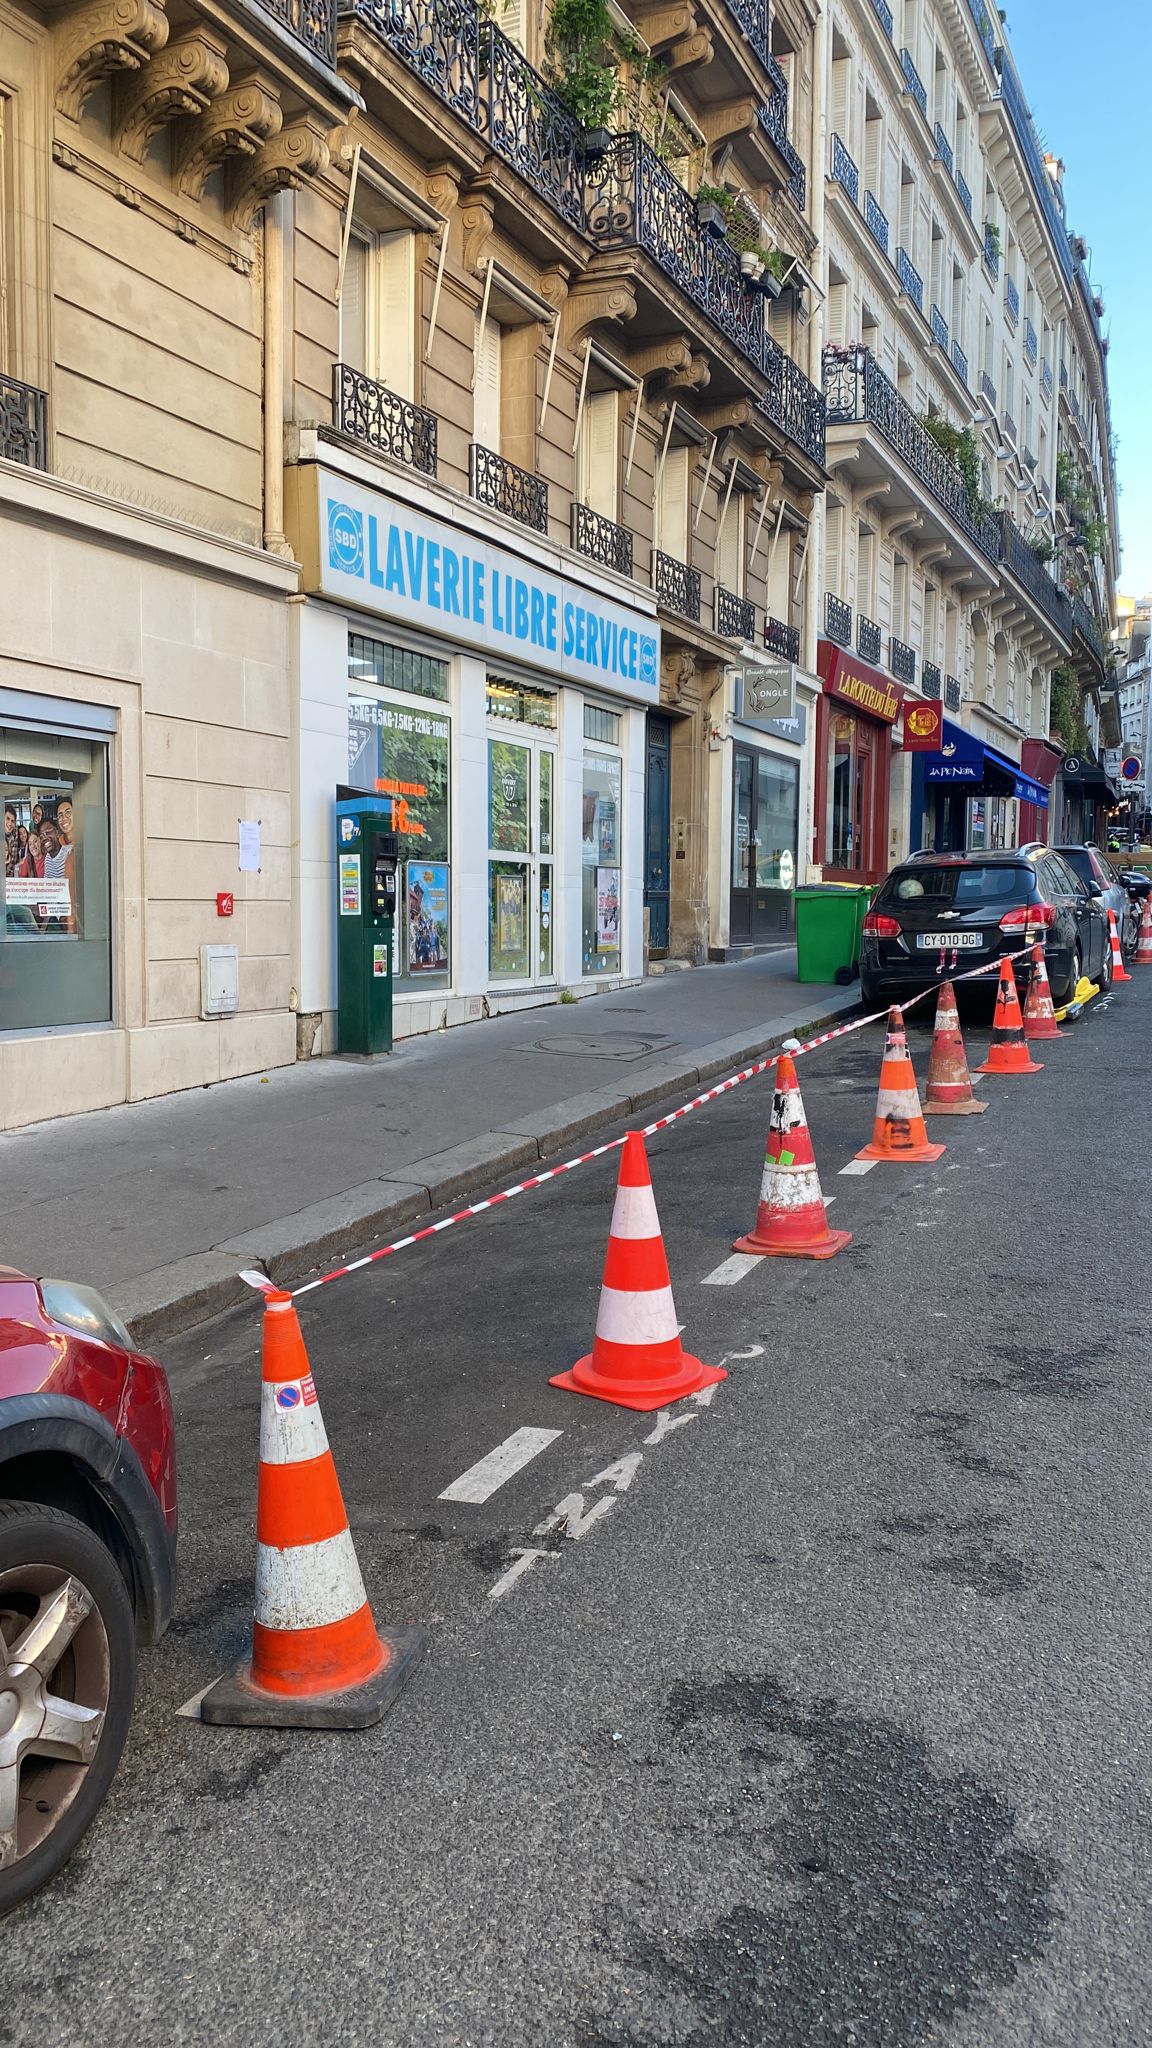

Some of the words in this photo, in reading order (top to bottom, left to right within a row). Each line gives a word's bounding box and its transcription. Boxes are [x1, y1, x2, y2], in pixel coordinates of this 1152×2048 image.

[335, 528, 357, 550] SBD
[368, 514, 485, 625] LAVERIE
[492, 568, 557, 653] LIBRE
[563, 601, 638, 681] SERVICE
[759, 689, 789, 697] ONGLE
[924, 934, 975, 946] CY-010-DG
